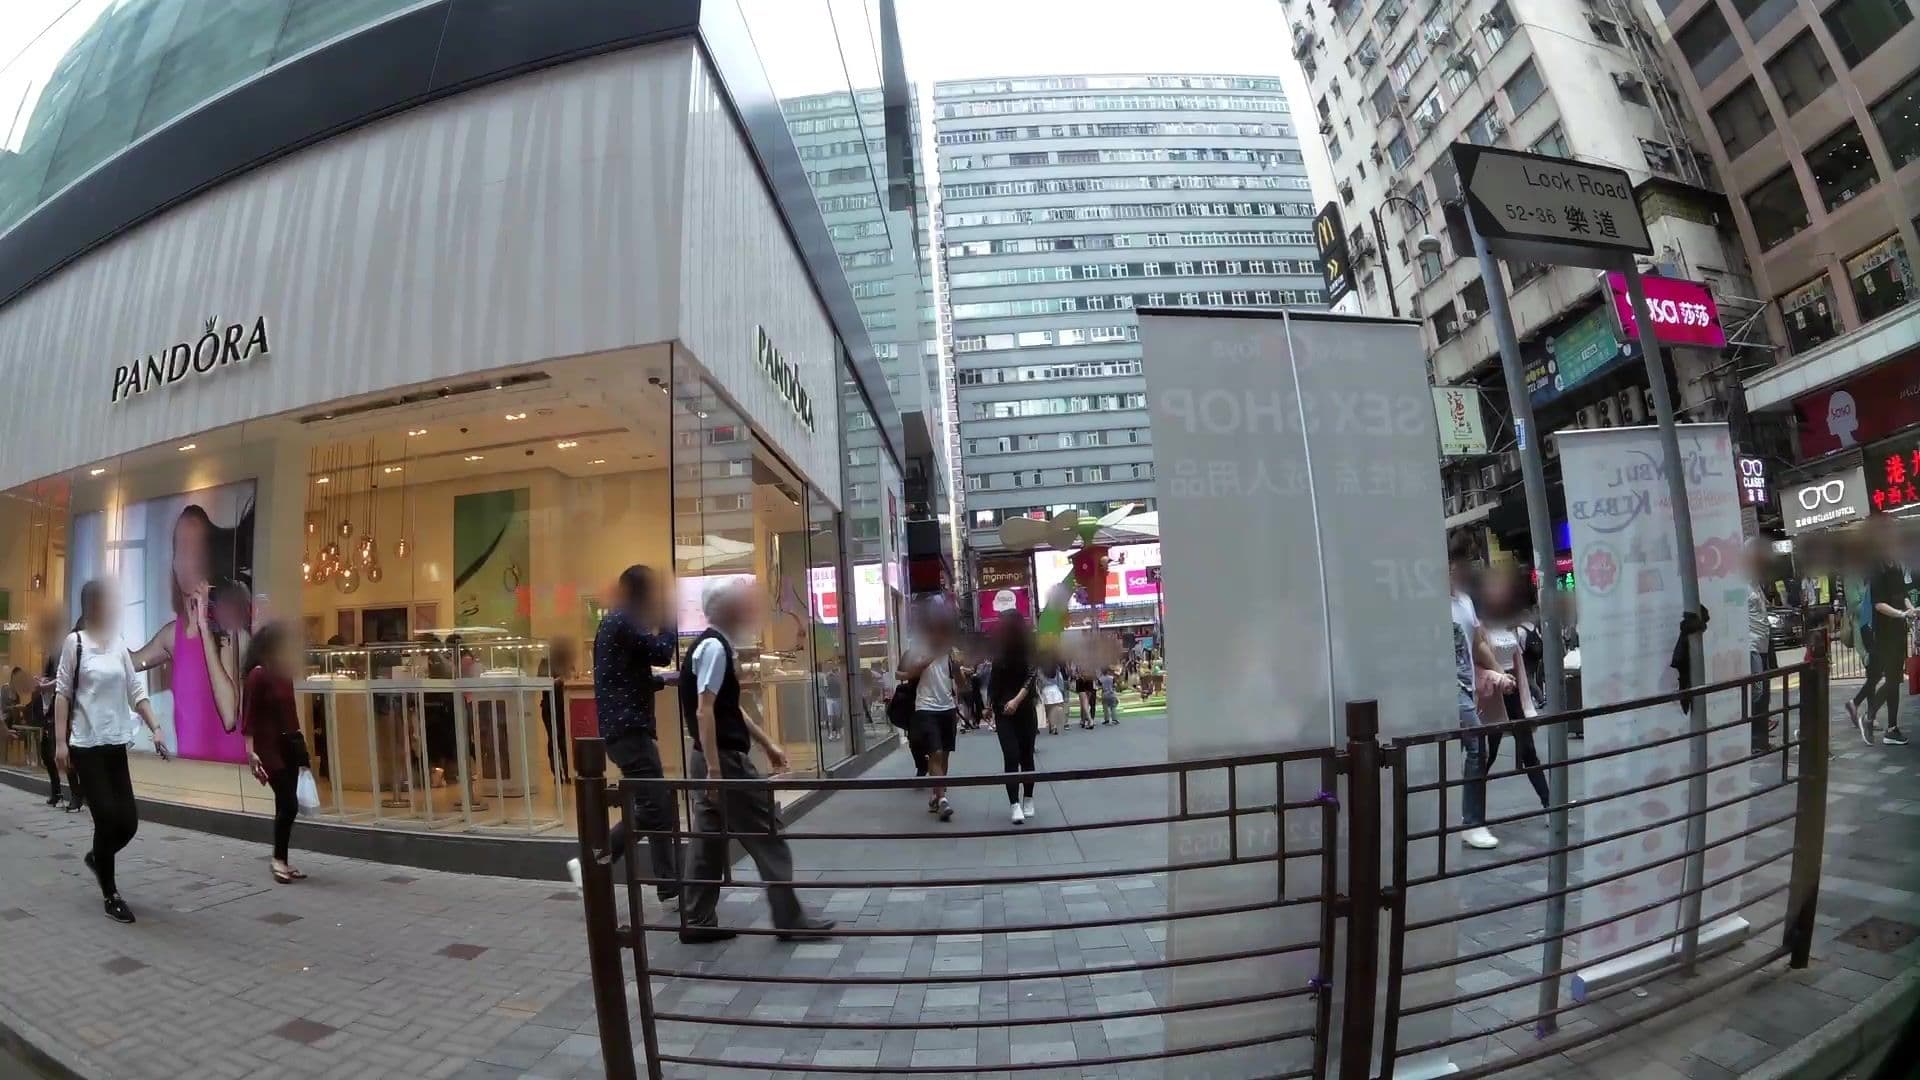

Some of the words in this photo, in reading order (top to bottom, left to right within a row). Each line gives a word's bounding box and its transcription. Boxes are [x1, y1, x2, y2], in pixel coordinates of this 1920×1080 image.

[1522, 165, 1574, 193] Lock
[1577, 173, 1629, 200] Road
[1505, 203, 1557, 225] 52-36
[1563, 205, 1621, 239] 樂道
[112, 316, 270, 402] PANDORA
[755, 324, 815, 433] PANDORA
